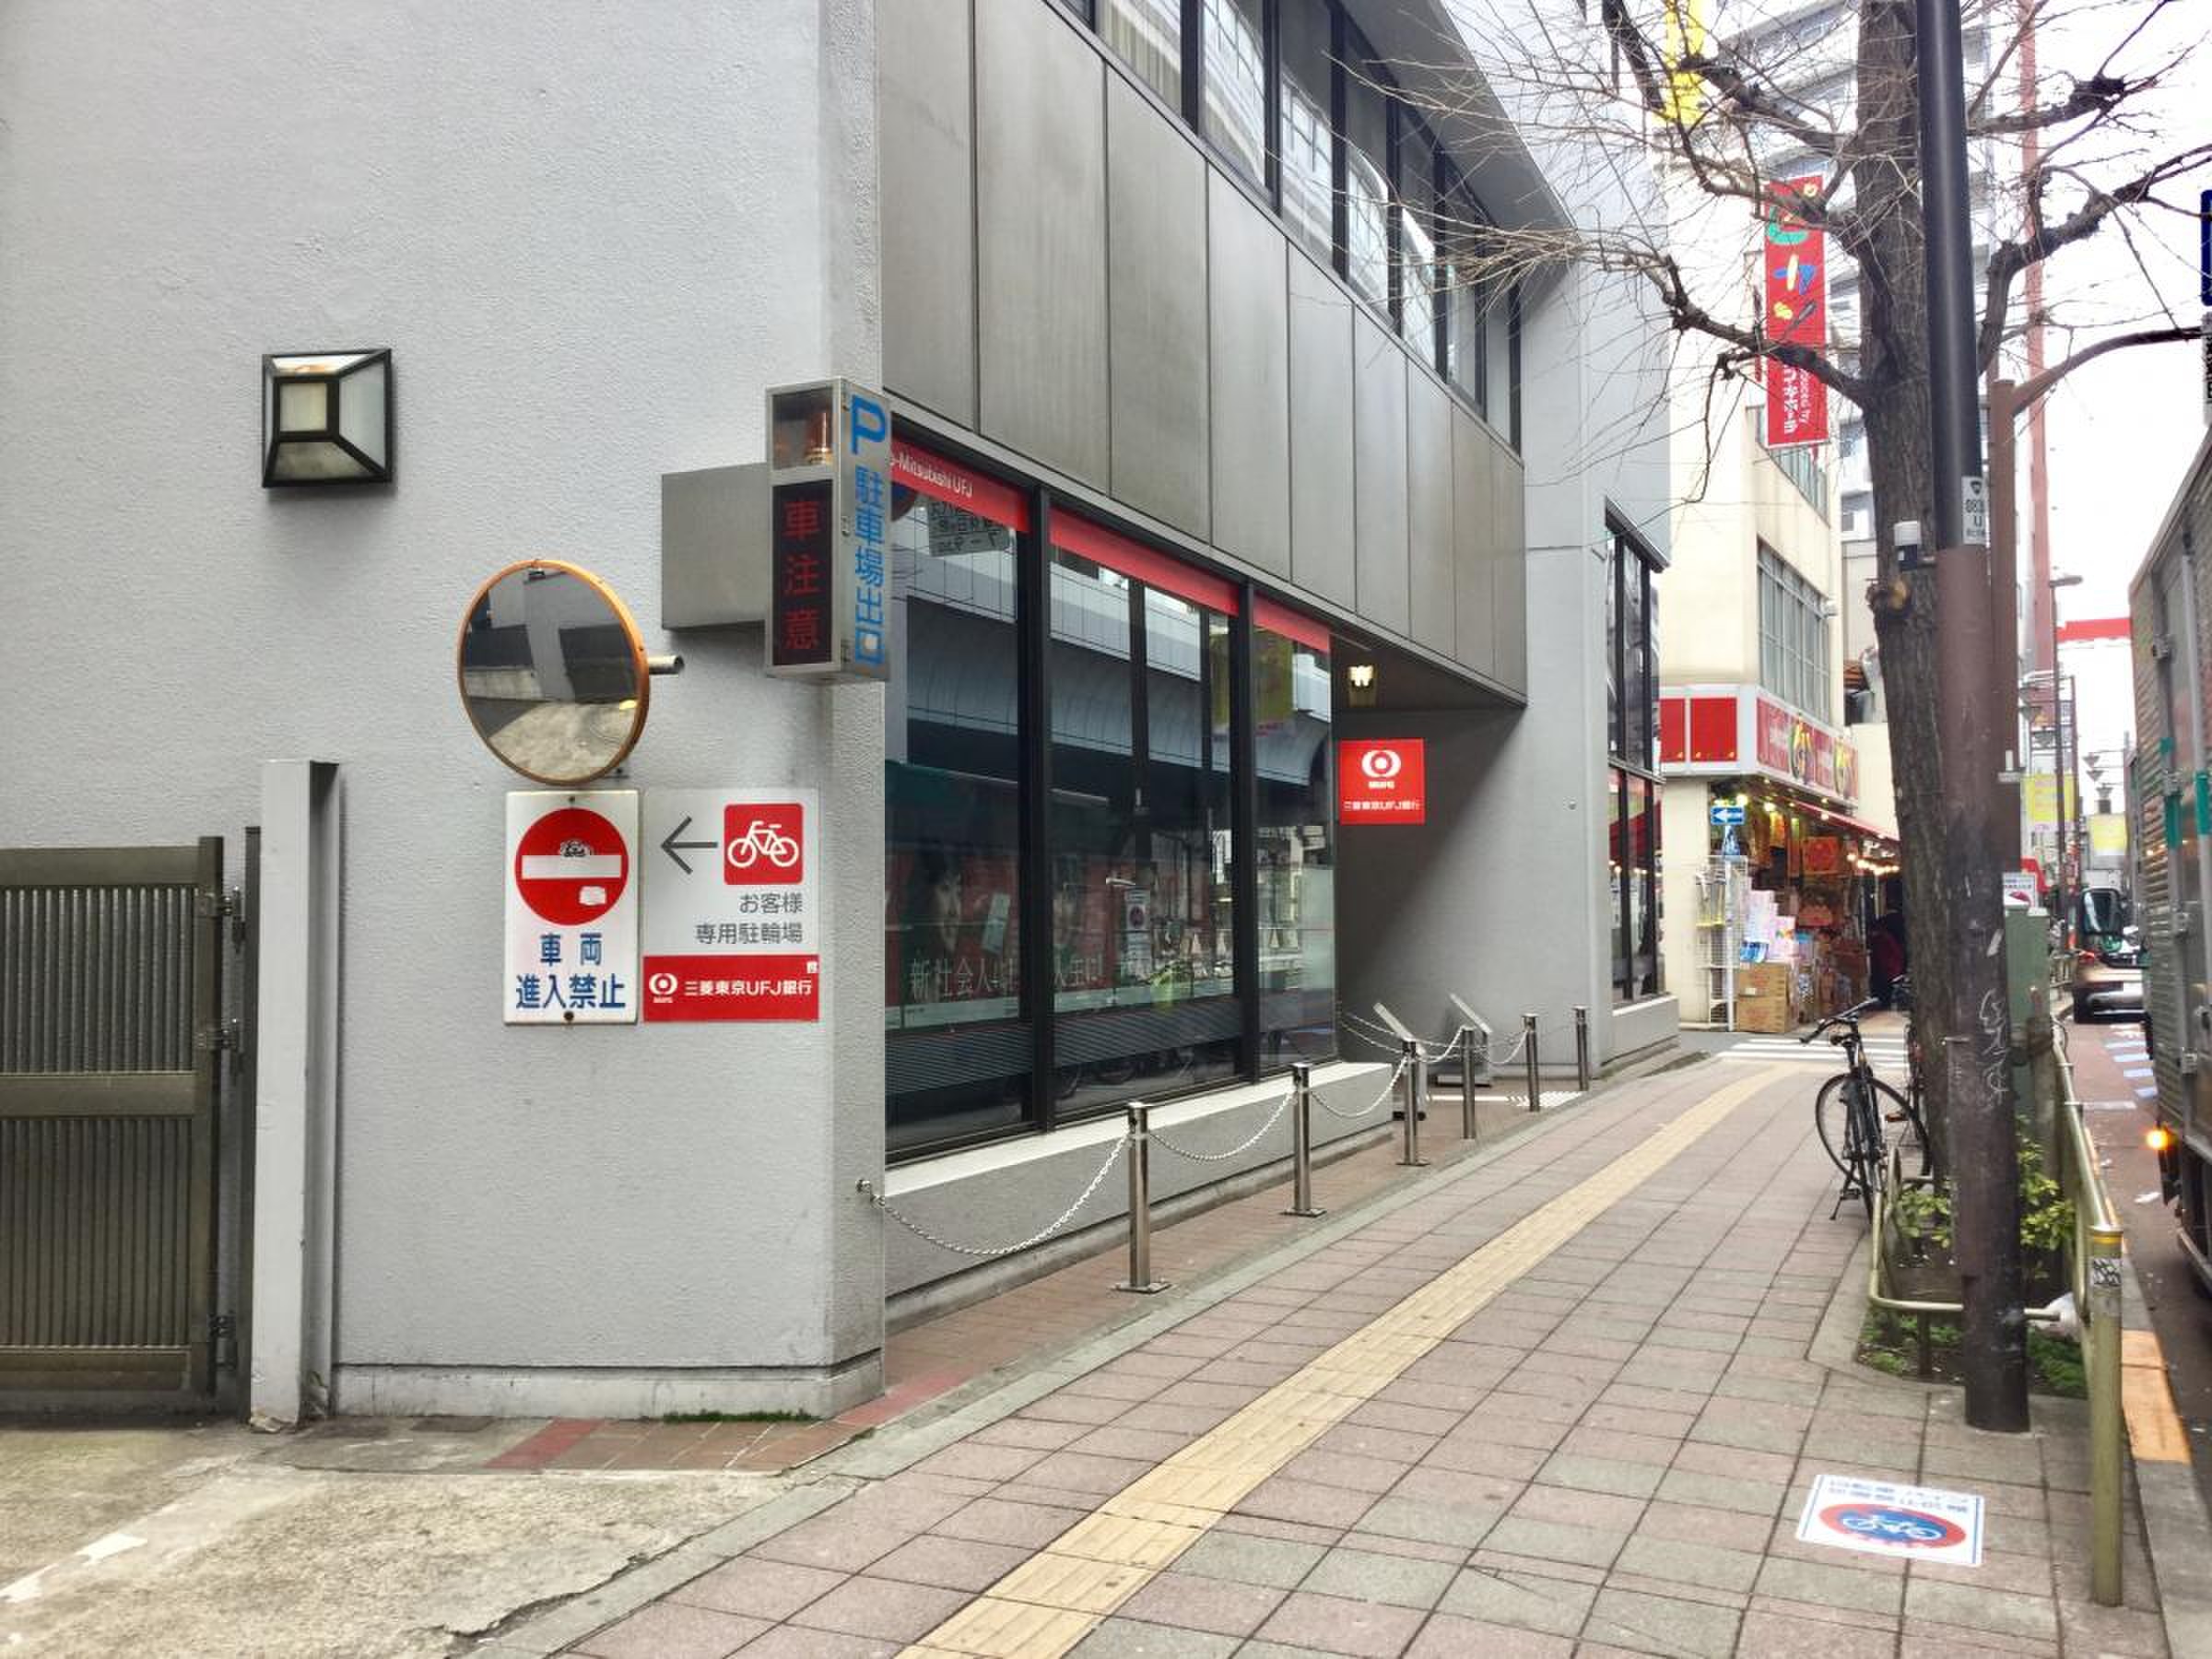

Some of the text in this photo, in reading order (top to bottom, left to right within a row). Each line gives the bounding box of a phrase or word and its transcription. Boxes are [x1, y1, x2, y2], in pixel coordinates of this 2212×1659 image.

[850, 394, 888, 455] P
[953, 474, 973, 499] UFJ
[785, 498, 821, 650] 車注意
[854, 465, 887, 665] 駐車場出口
[739, 892, 803, 914] お客様
[696, 923, 803, 945] 専用駐輪場
[515, 973, 627, 1010] 進入禁止
[684, 980, 812, 997] 三菱東京UFJ銀行
